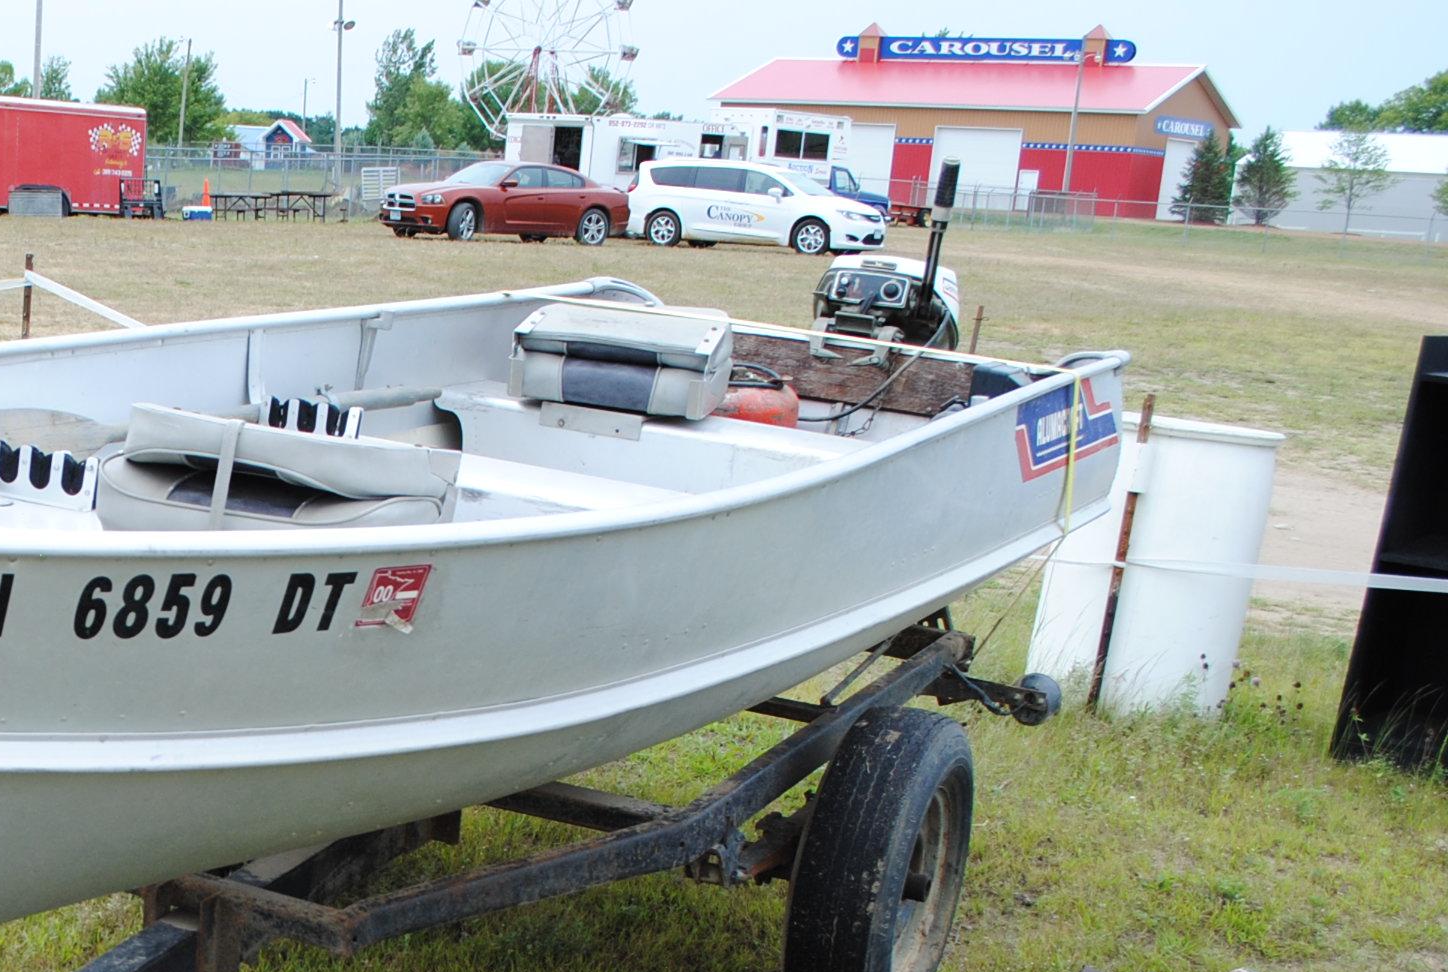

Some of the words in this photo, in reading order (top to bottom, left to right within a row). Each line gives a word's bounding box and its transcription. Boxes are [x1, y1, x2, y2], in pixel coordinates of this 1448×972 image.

[889, 40, 1069, 57] CAROUSEL
[1162, 120, 1205, 137] CAROUSEL
[707, 204, 754, 224] CANOPY
[373, 585, 394, 603] 00
[73, 574, 232, 640] 6859
[272, 572, 358, 635] DT
